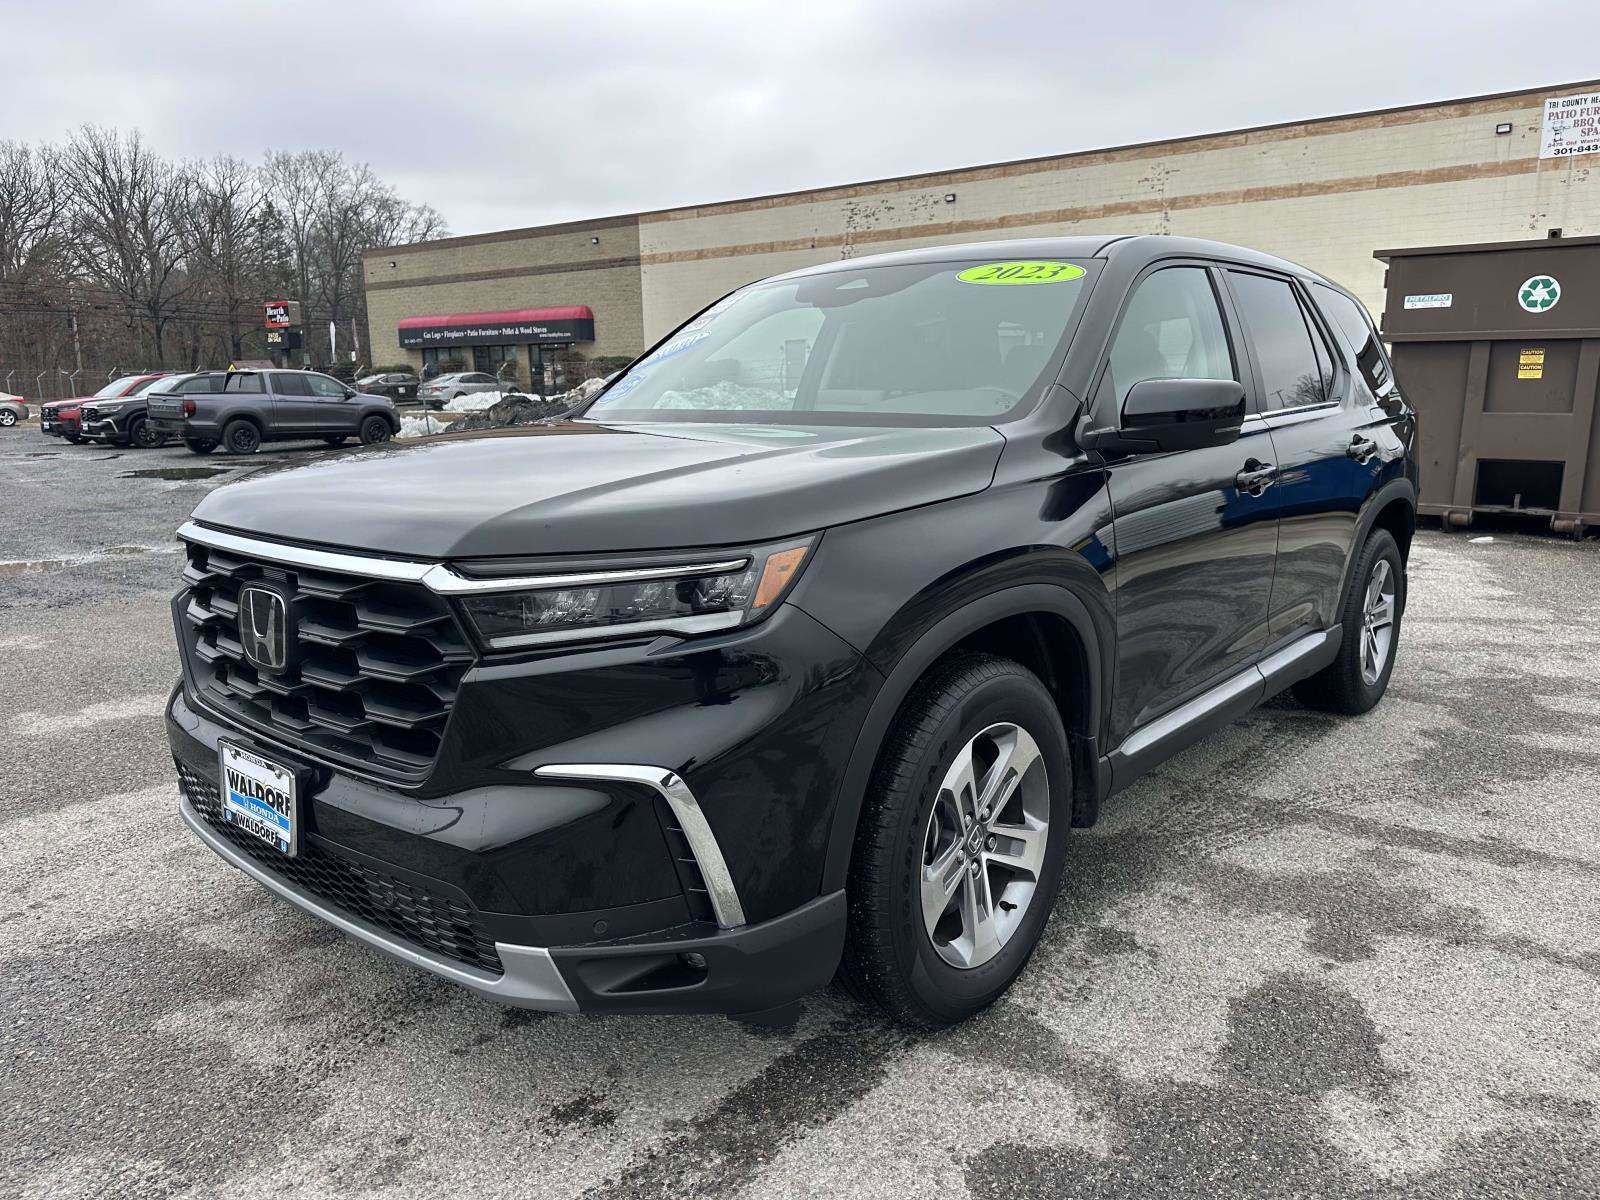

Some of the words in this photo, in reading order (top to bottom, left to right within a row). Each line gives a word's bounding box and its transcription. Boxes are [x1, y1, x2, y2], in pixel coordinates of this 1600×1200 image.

[1562, 98, 1588, 107] COUNTY
[1548, 109, 1577, 120] PATIO
[1573, 117, 1595, 128] BBQ
[975, 265, 1067, 280] 2023
[266, 306, 284, 315] Hearth
[423, 331, 431, 339] Gas
[443, 330, 464, 339] Fireplaces
[467, 328, 478, 337] Patio
[478, 328, 500, 337] Furniture
[520, 326, 533, 334] Wood
[533, 326, 548, 334] Stoves
[250, 803, 280, 823] HONDA
[237, 812, 276, 844] WALDORF
